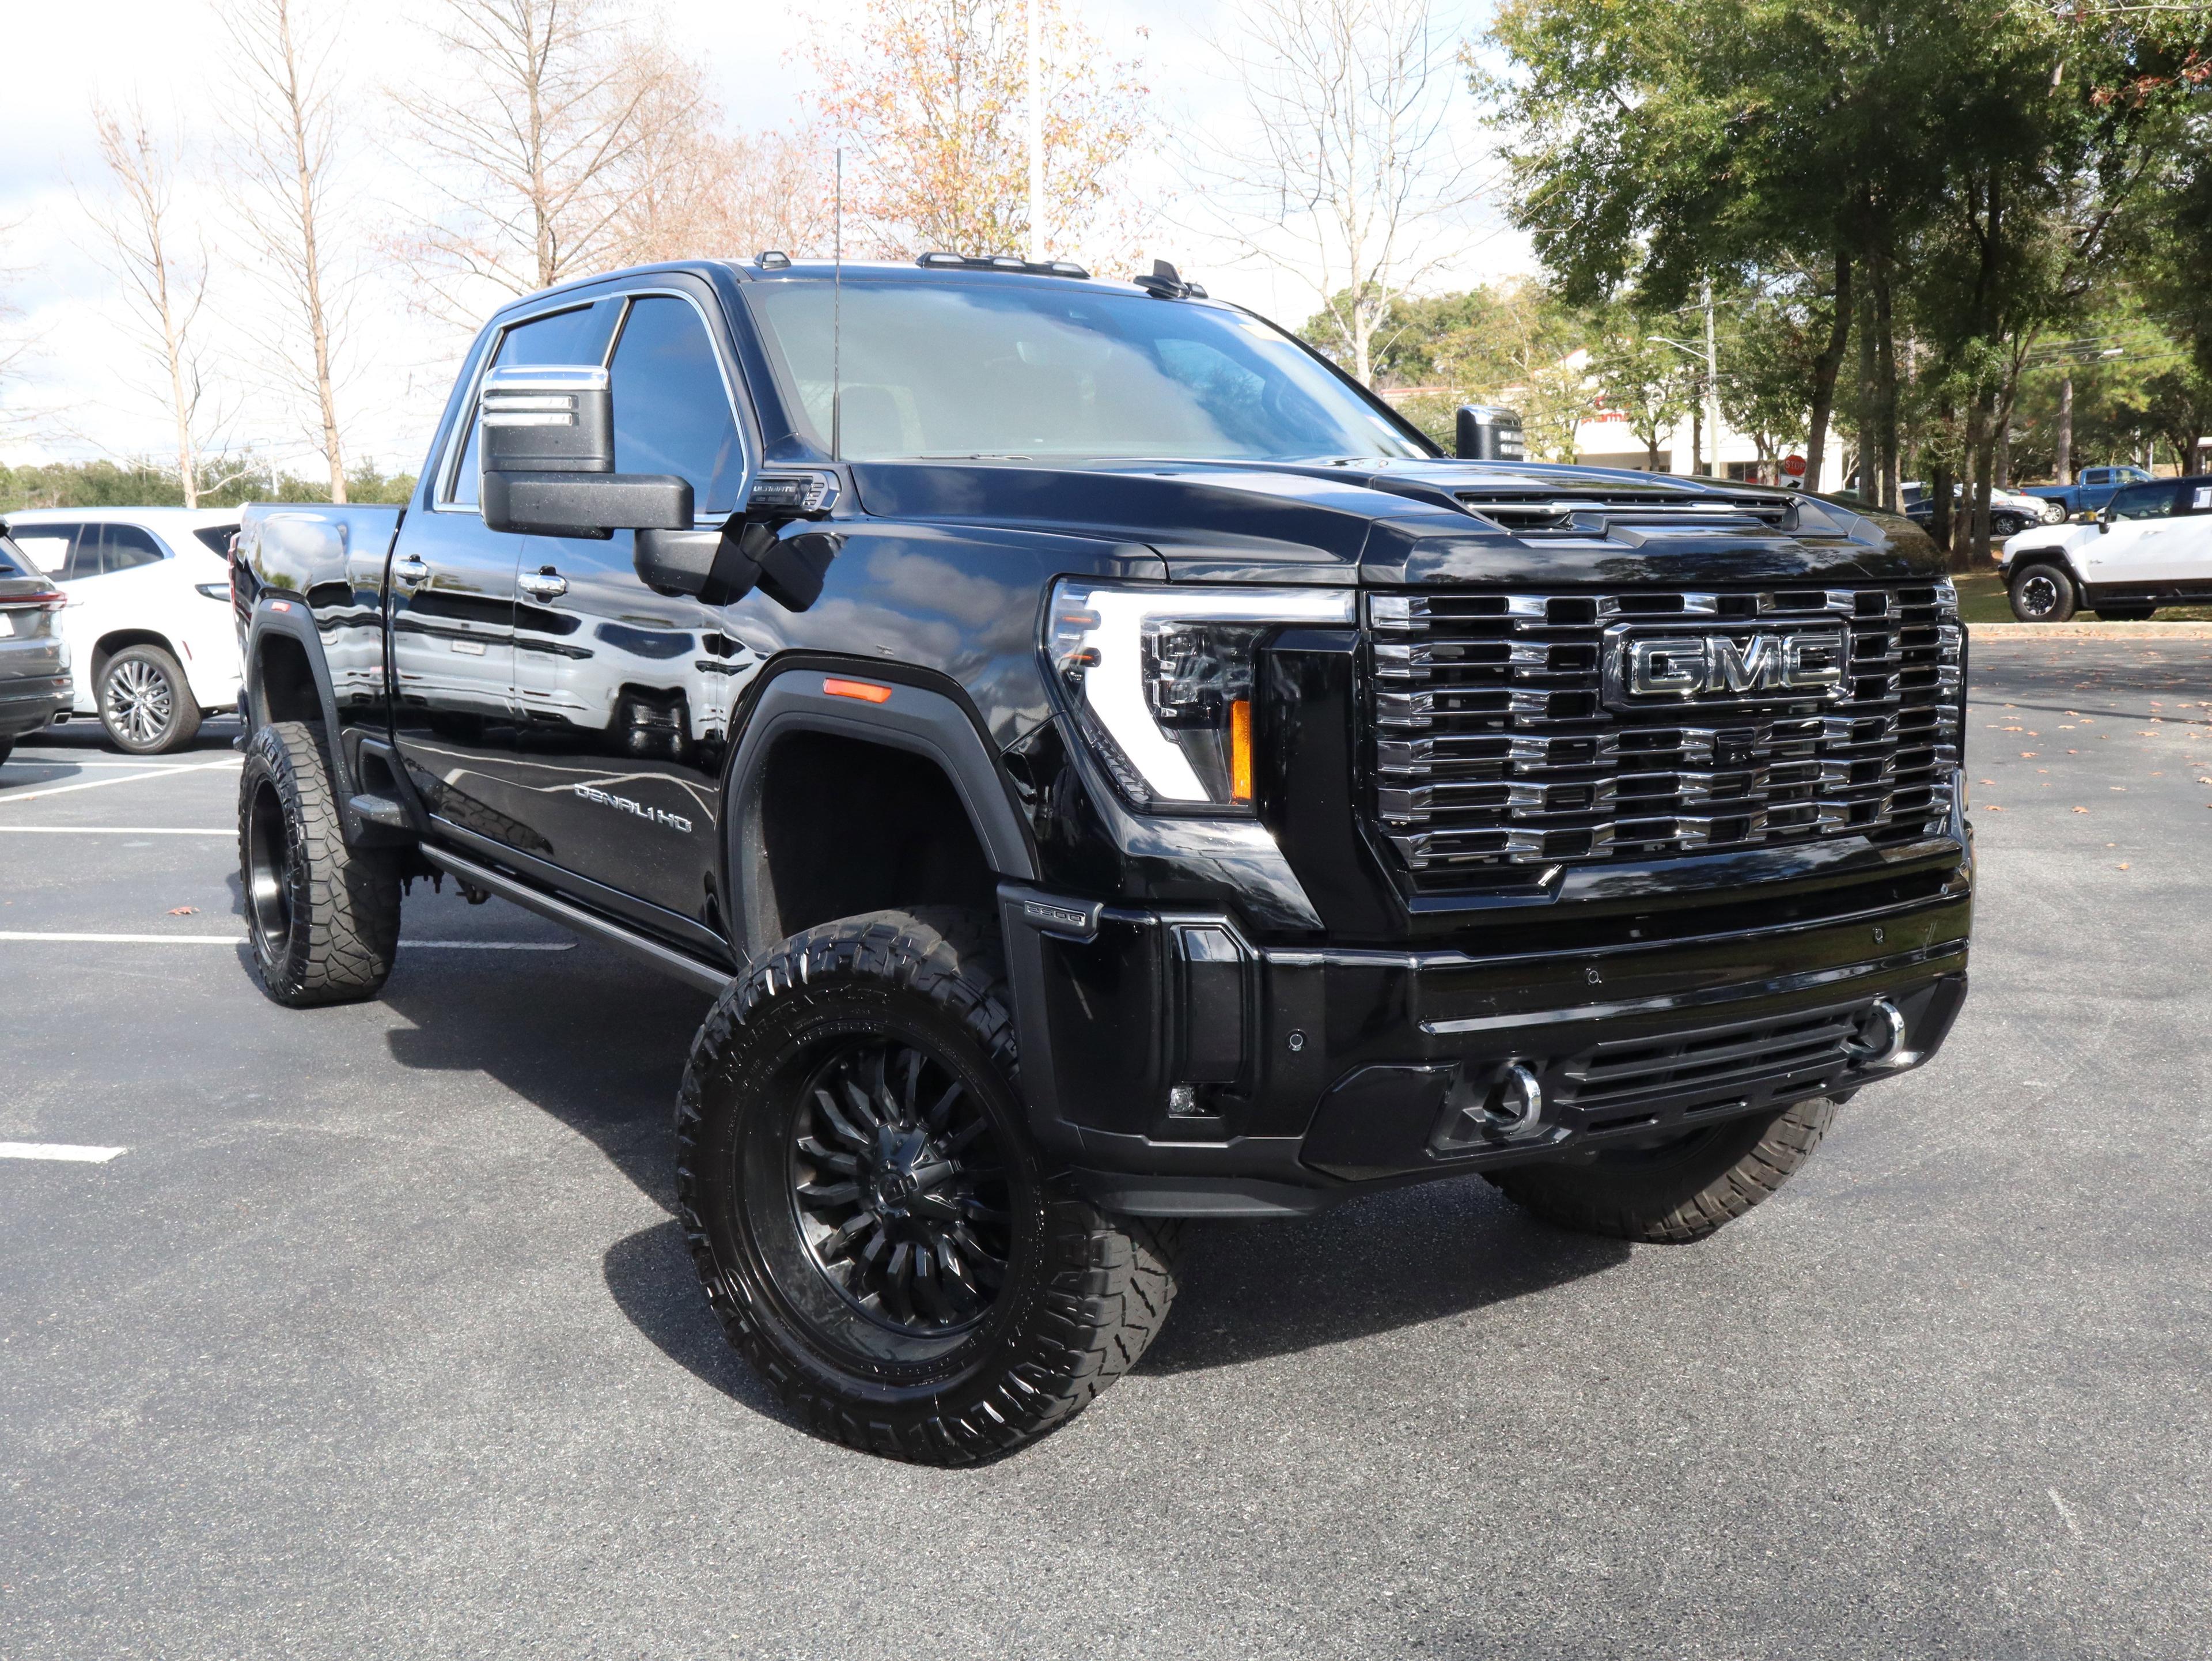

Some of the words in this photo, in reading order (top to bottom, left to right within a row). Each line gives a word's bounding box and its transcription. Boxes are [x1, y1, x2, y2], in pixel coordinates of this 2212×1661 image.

[1786, 460, 1805, 470] STOP
[1630, 634, 1842, 694] GMC
[574, 783, 654, 821] DENALI
[657, 809, 692, 833] HD
[1027, 905, 1082, 922] 2500
